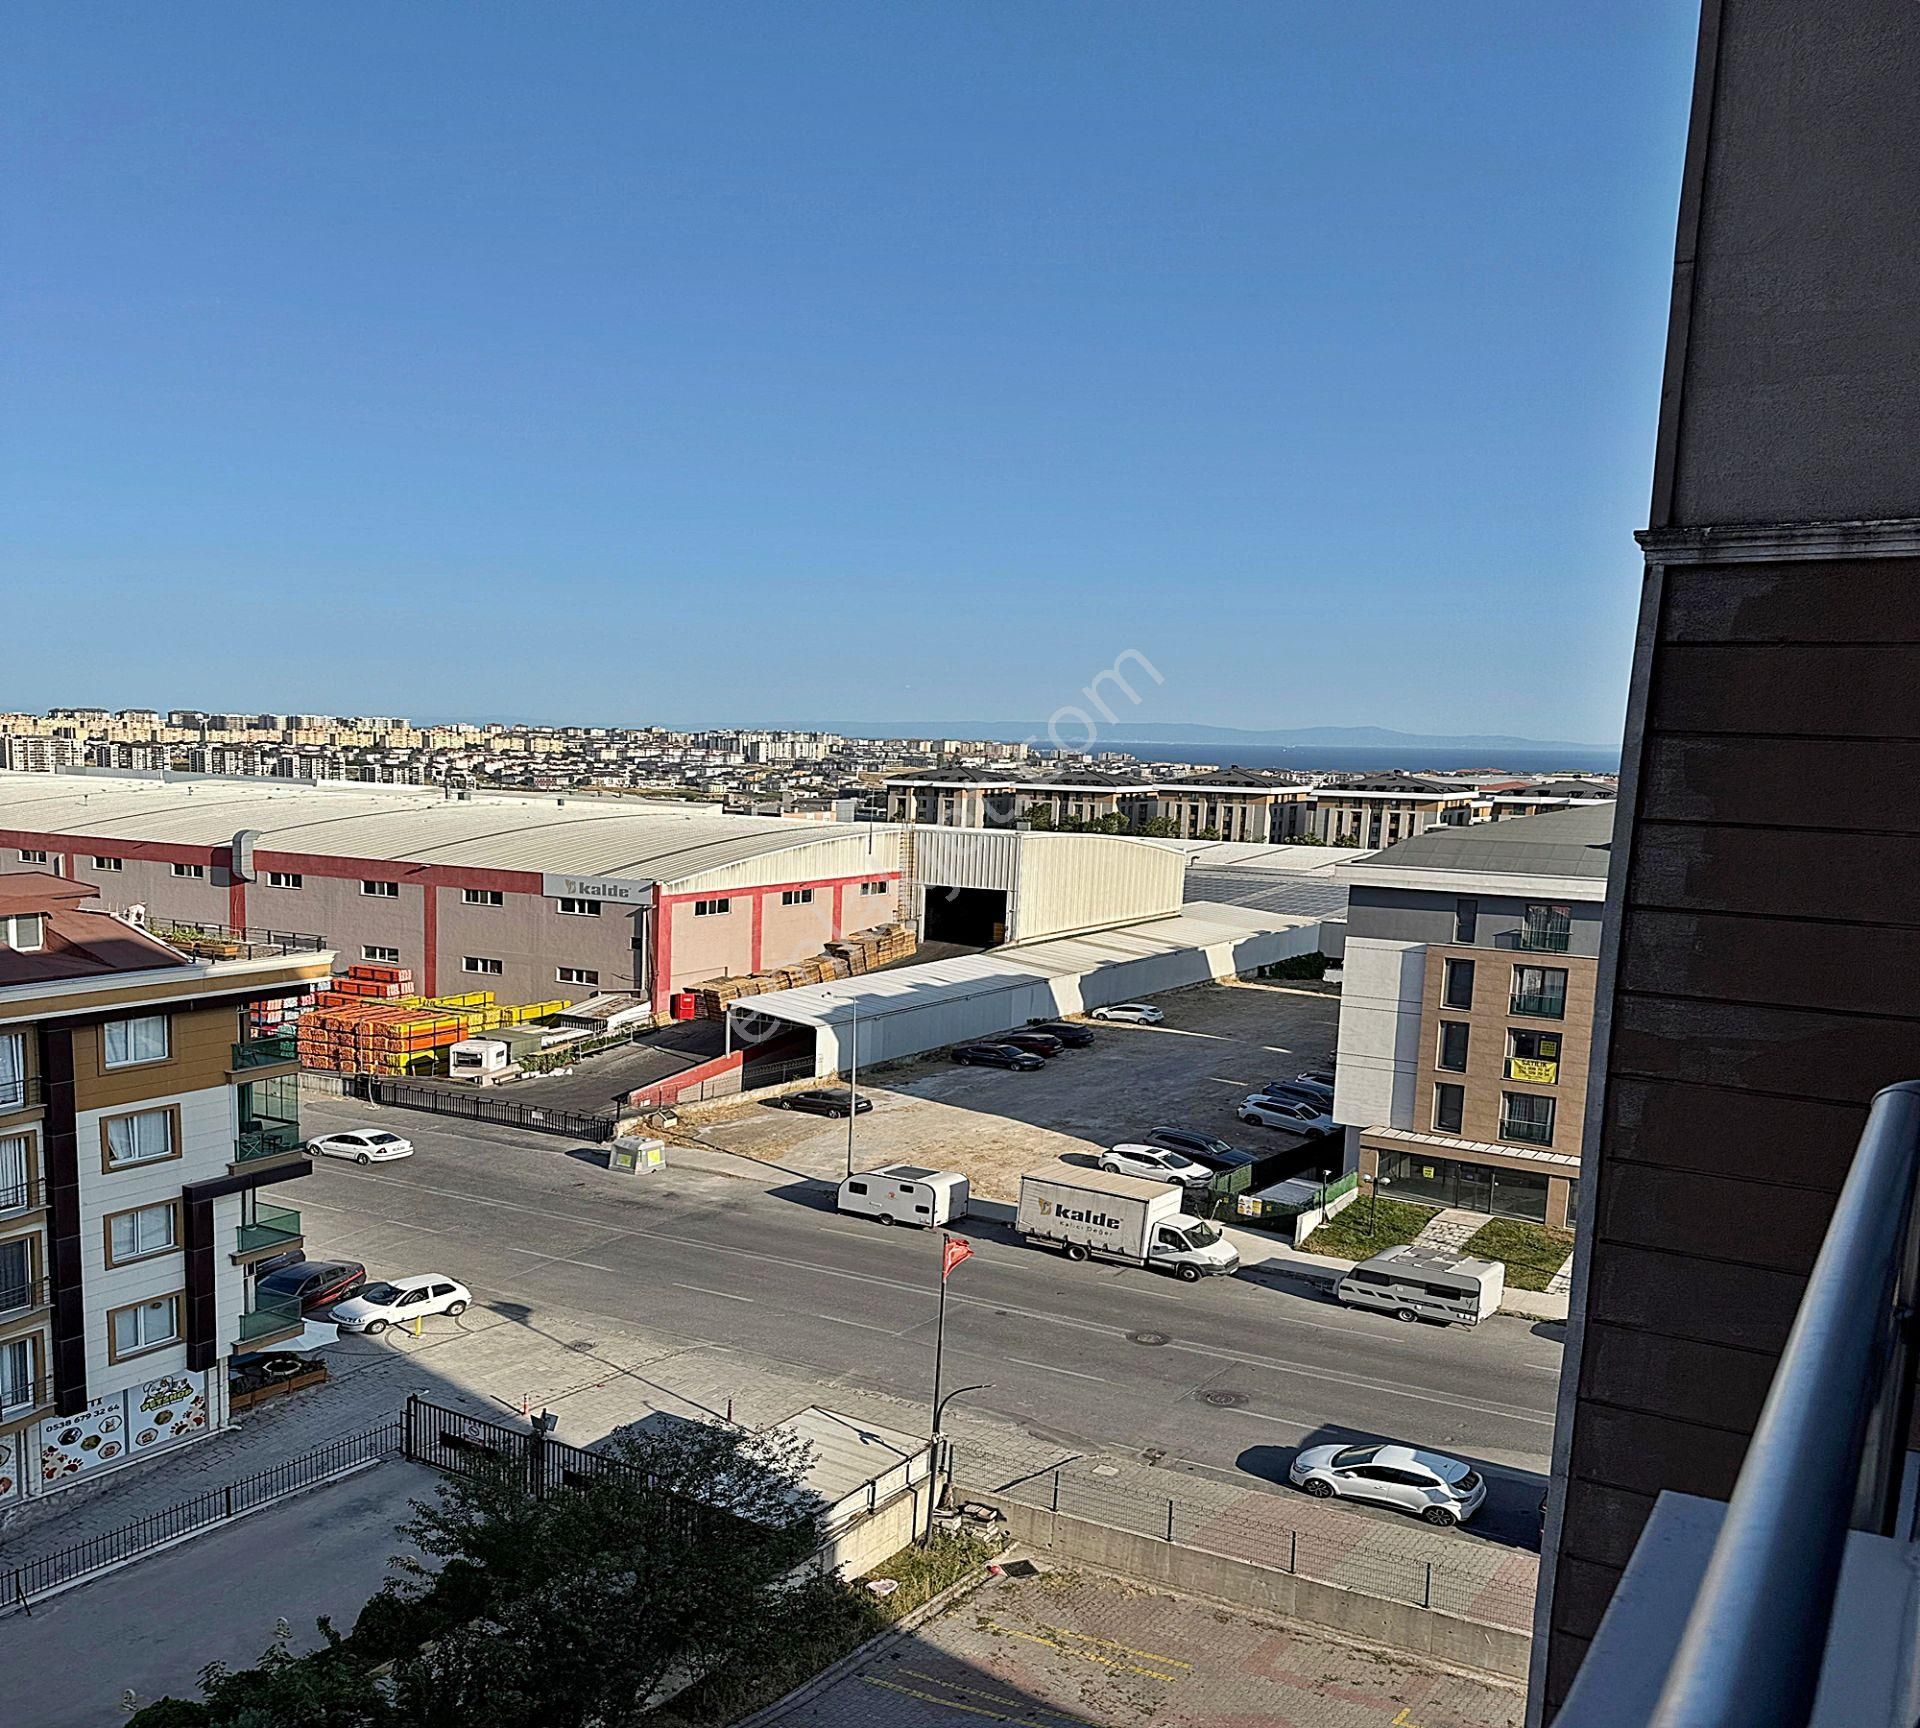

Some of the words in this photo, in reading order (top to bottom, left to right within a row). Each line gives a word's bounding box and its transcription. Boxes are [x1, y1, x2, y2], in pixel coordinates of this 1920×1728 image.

[579, 882, 629, 898] kalde
[1055, 1203, 1120, 1230] kalde
[74, 1413, 91, 1423] 679
[94, 1408, 106, 1417] 32
[107, 1404, 120, 1412] 64
